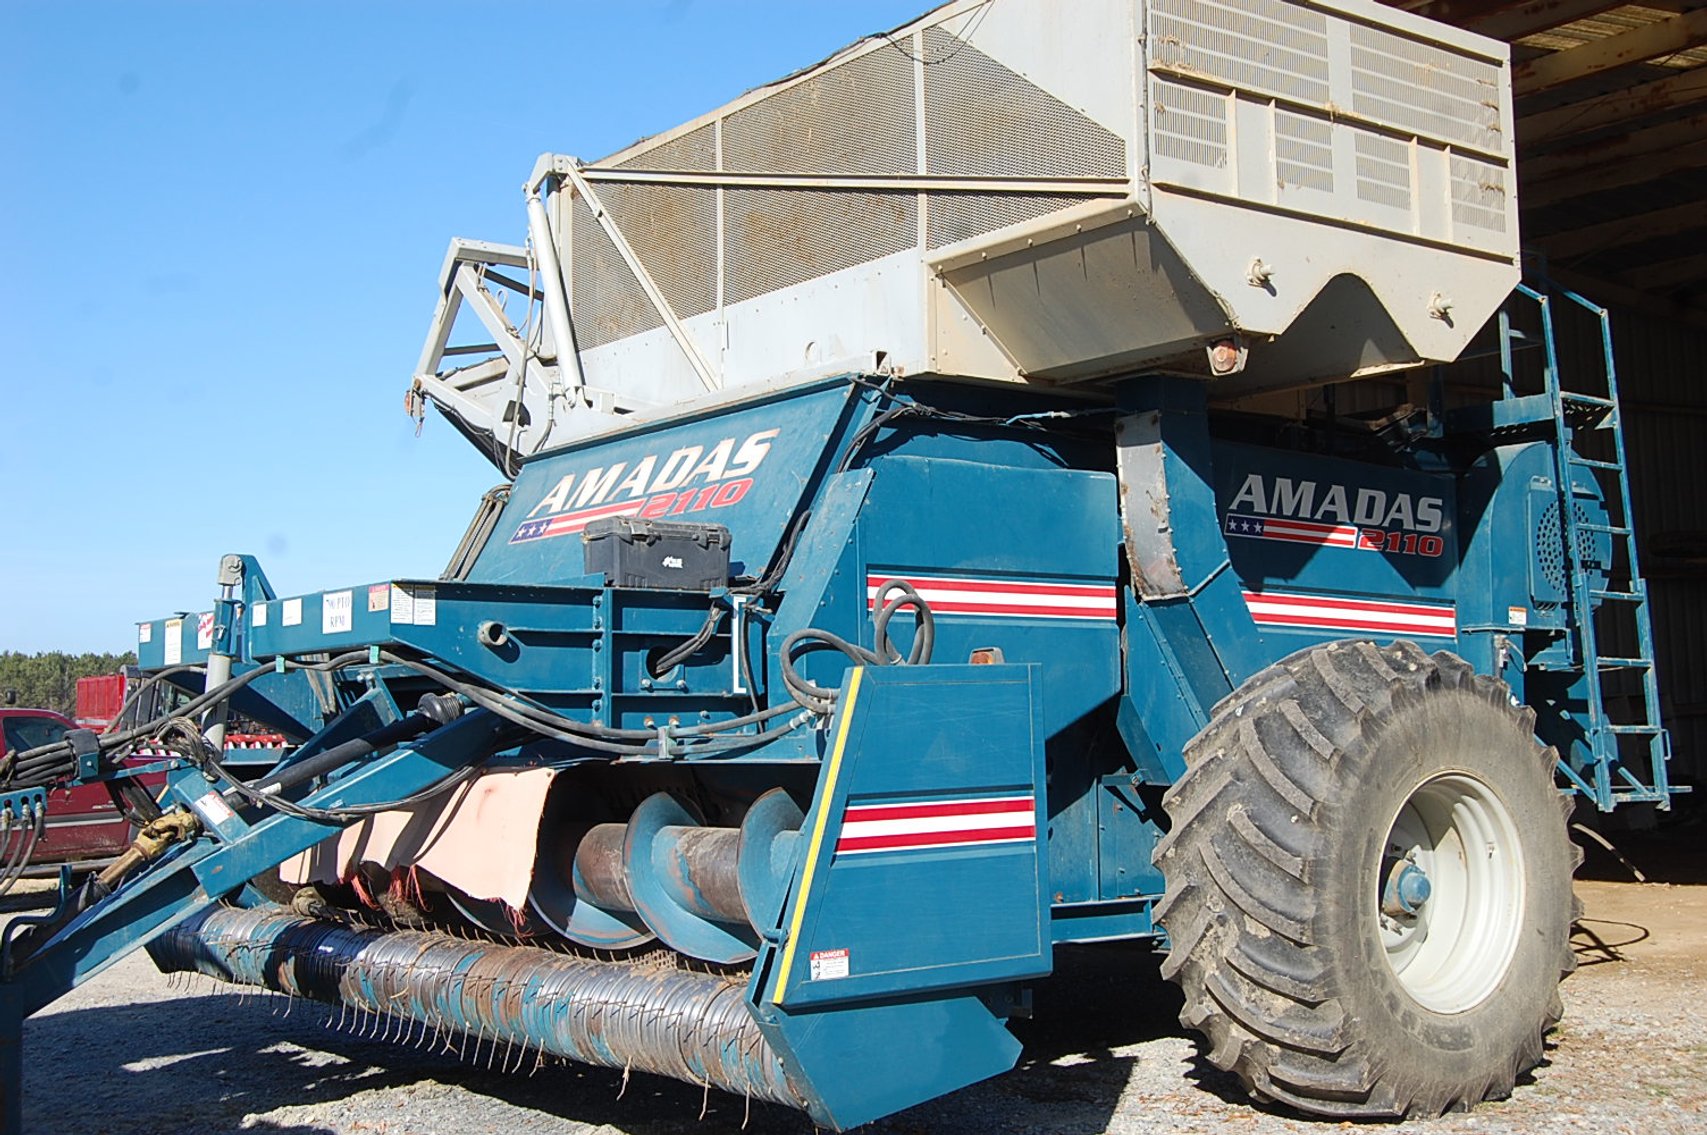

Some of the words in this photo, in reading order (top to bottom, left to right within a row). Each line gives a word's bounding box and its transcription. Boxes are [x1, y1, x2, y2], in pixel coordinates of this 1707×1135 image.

[526, 428, 781, 518] AMADAS
[637, 477, 754, 518] 2110
[1228, 473, 1443, 533] AMADAS
[1357, 528, 1444, 557] 2110
[820, 949, 845, 959] DANGER
